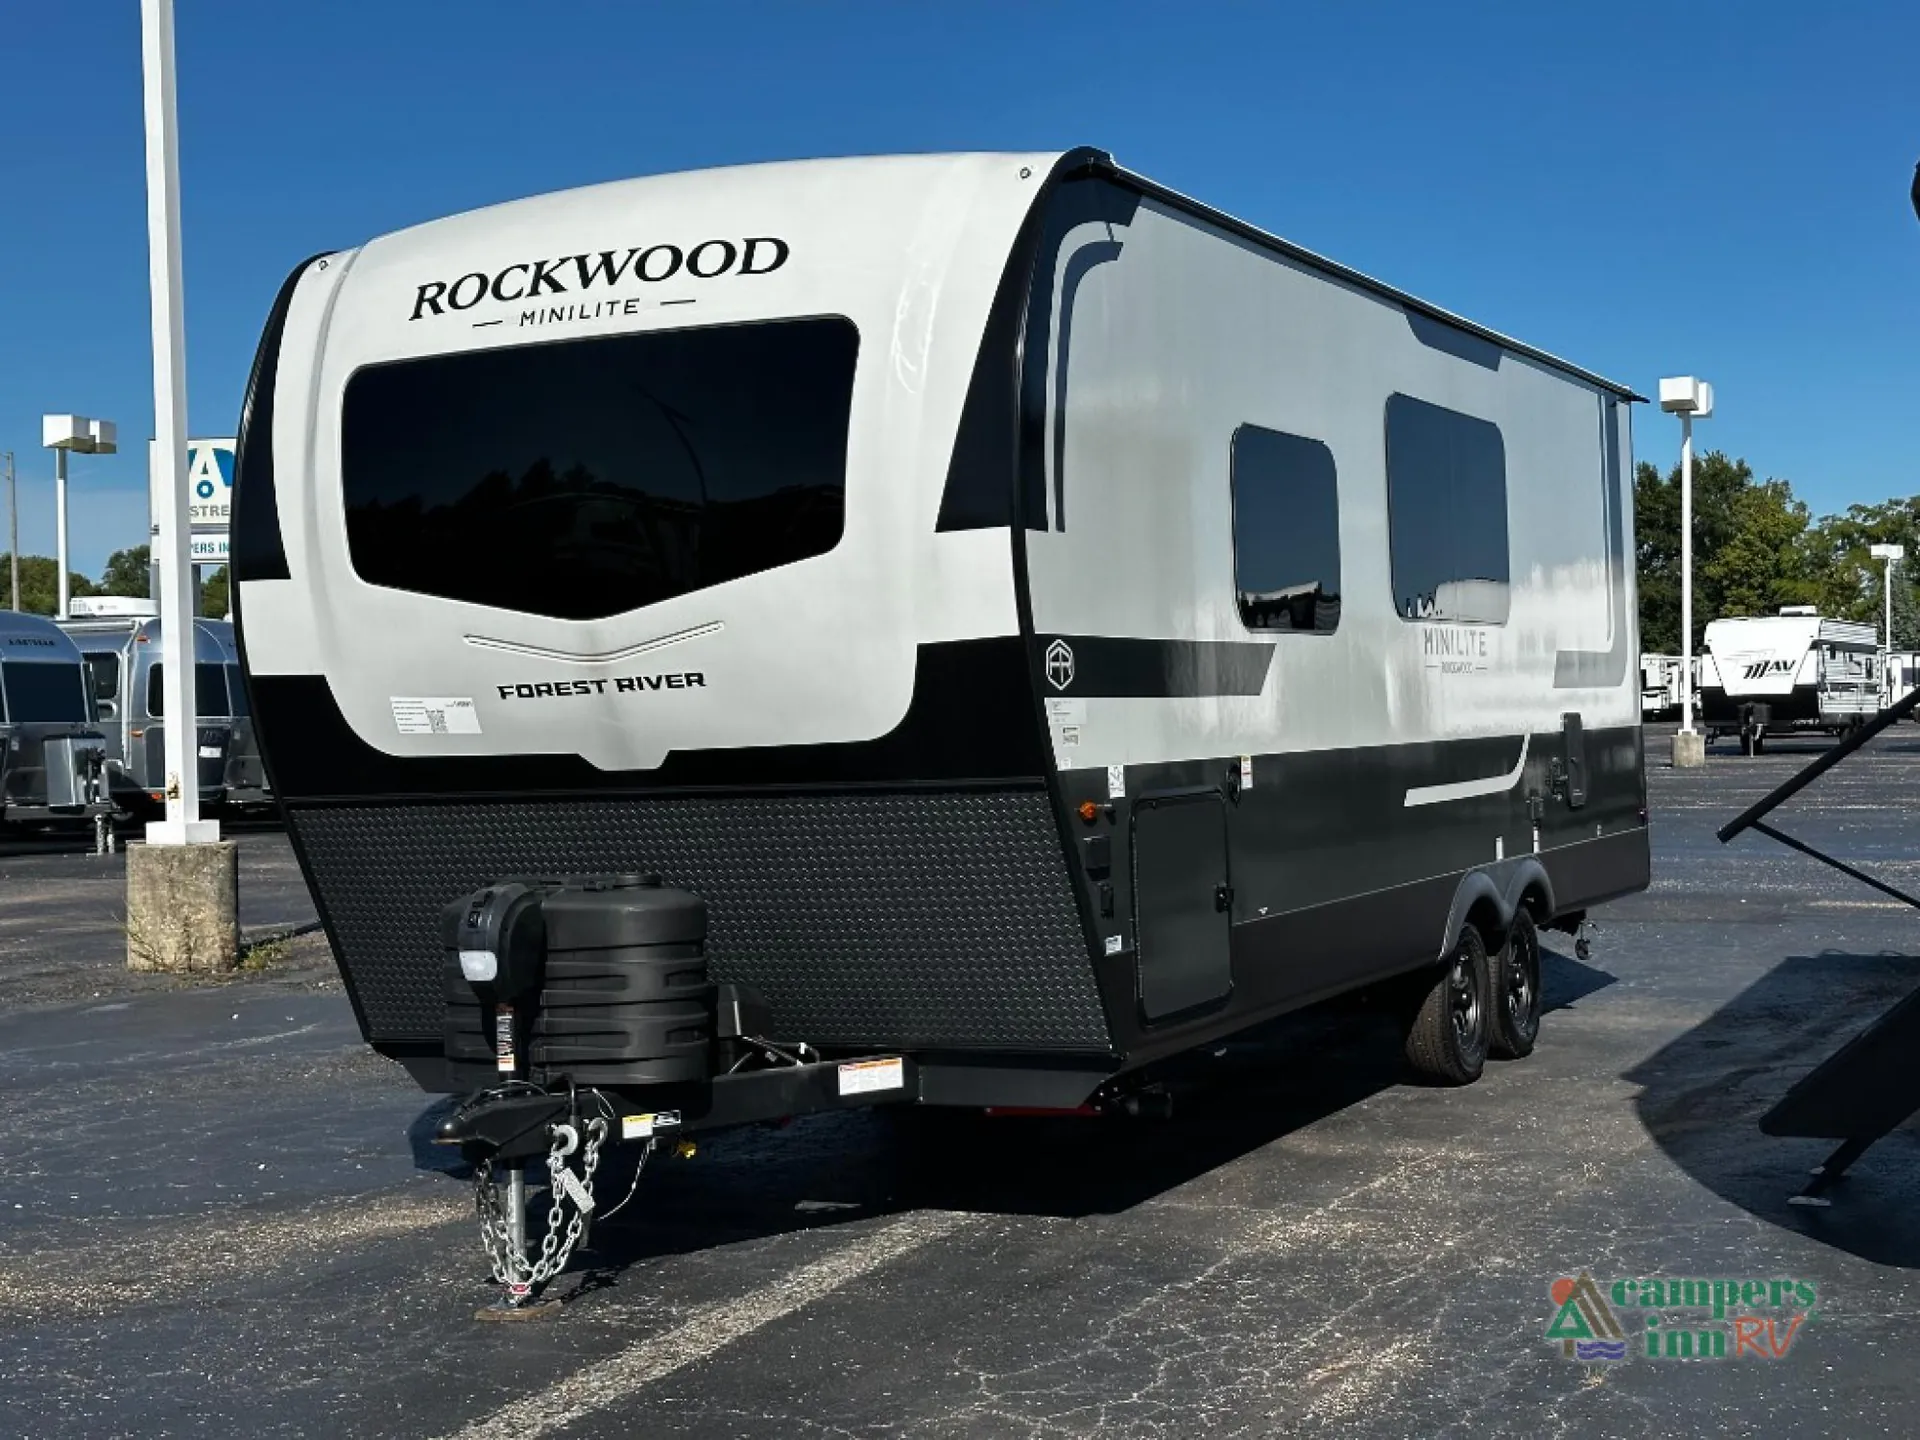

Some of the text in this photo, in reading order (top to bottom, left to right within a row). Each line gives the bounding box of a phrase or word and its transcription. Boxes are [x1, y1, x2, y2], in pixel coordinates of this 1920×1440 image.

[408, 237, 790, 321] ROCKWOOD
[519, 297, 640, 328] MINILITE
[189, 503, 231, 517] STRE
[1424, 627, 1488, 657] MINILITE
[497, 671, 707, 700] FOREST RIVER
